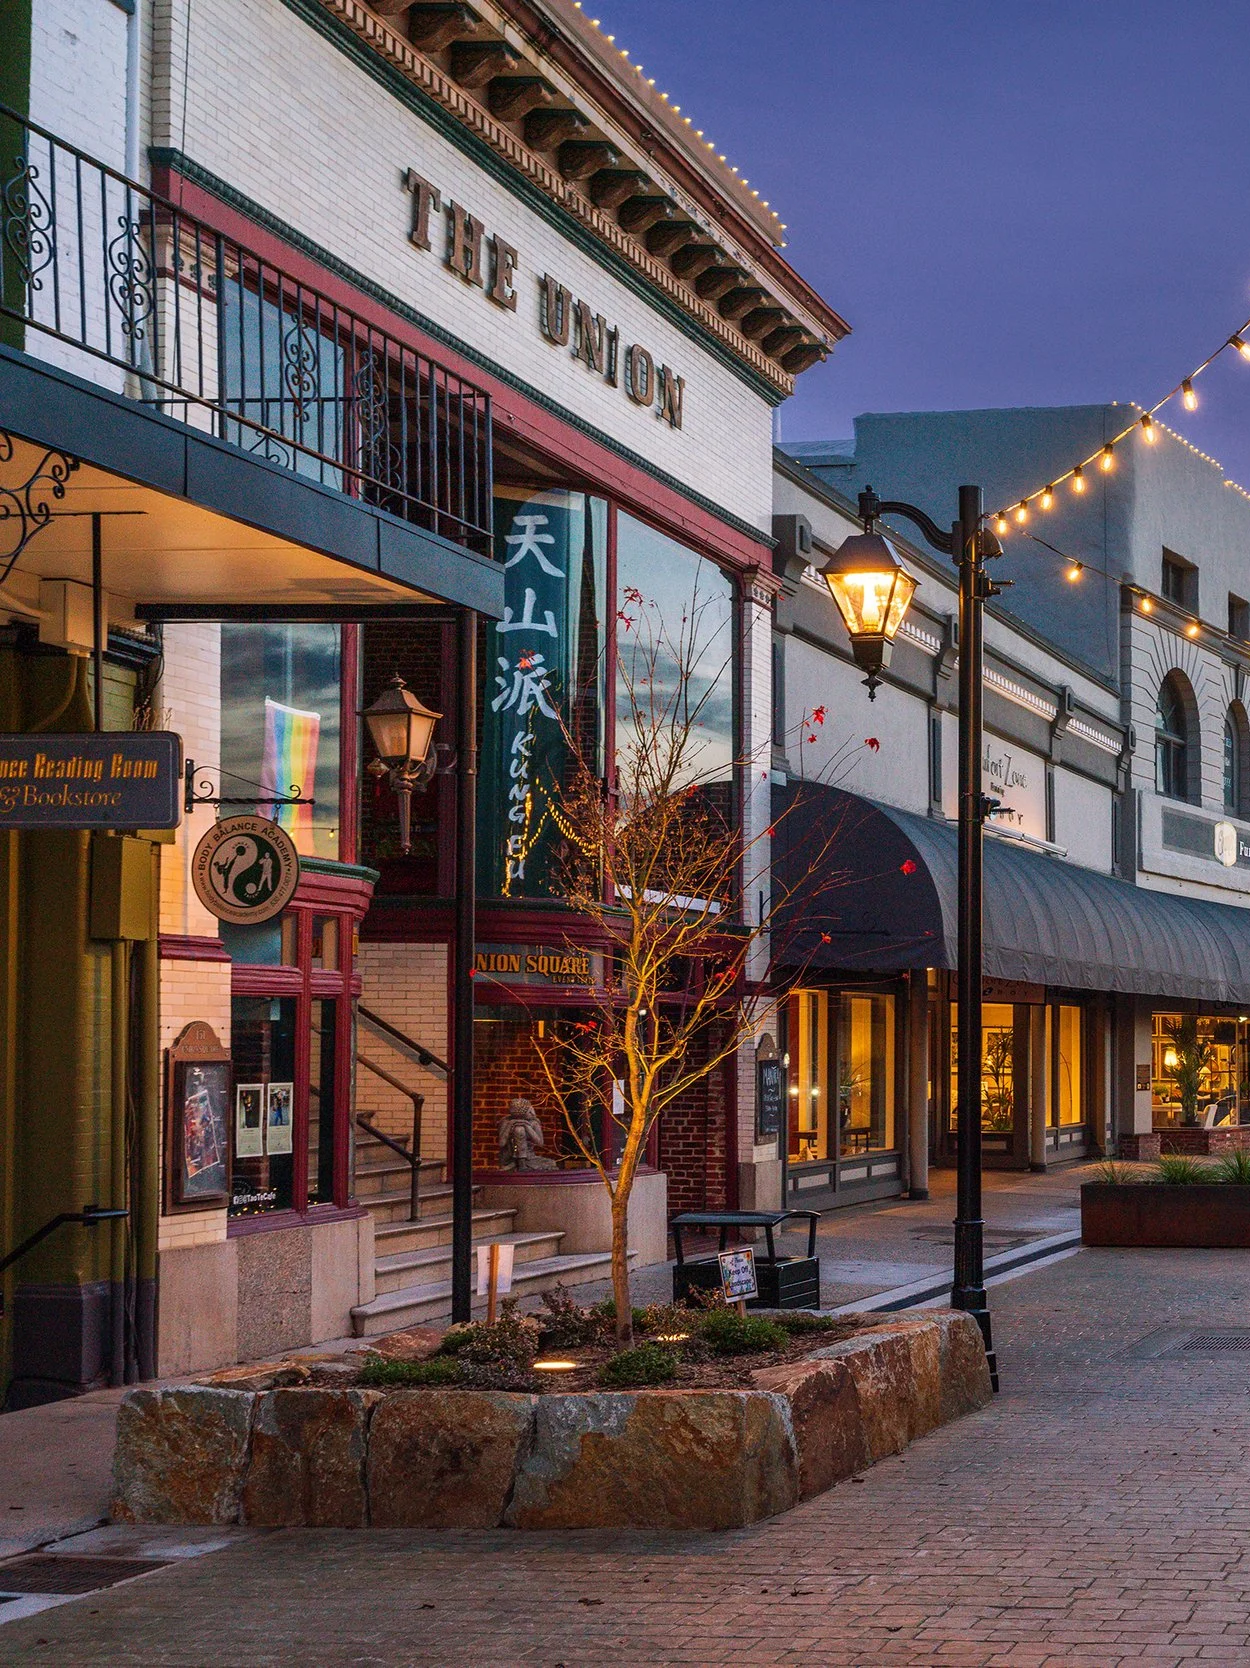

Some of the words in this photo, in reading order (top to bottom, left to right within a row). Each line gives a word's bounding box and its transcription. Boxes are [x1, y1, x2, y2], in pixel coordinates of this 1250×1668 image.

[407, 167, 518, 312] THE
[543, 272, 686, 430] UNION
[491, 514, 566, 721] 天山派
[34, 753, 104, 783] Reading
[110, 753, 159, 780] Room
[508, 731, 535, 824] KUNG
[23, 784, 122, 807] Bookstore
[198, 842, 213, 871] BODY
[213, 822, 258, 842] BALANCE
[261, 827, 292, 869] ACADEMY
[475, 953, 521, 973] NION
[526, 954, 590, 977] SQUARE
